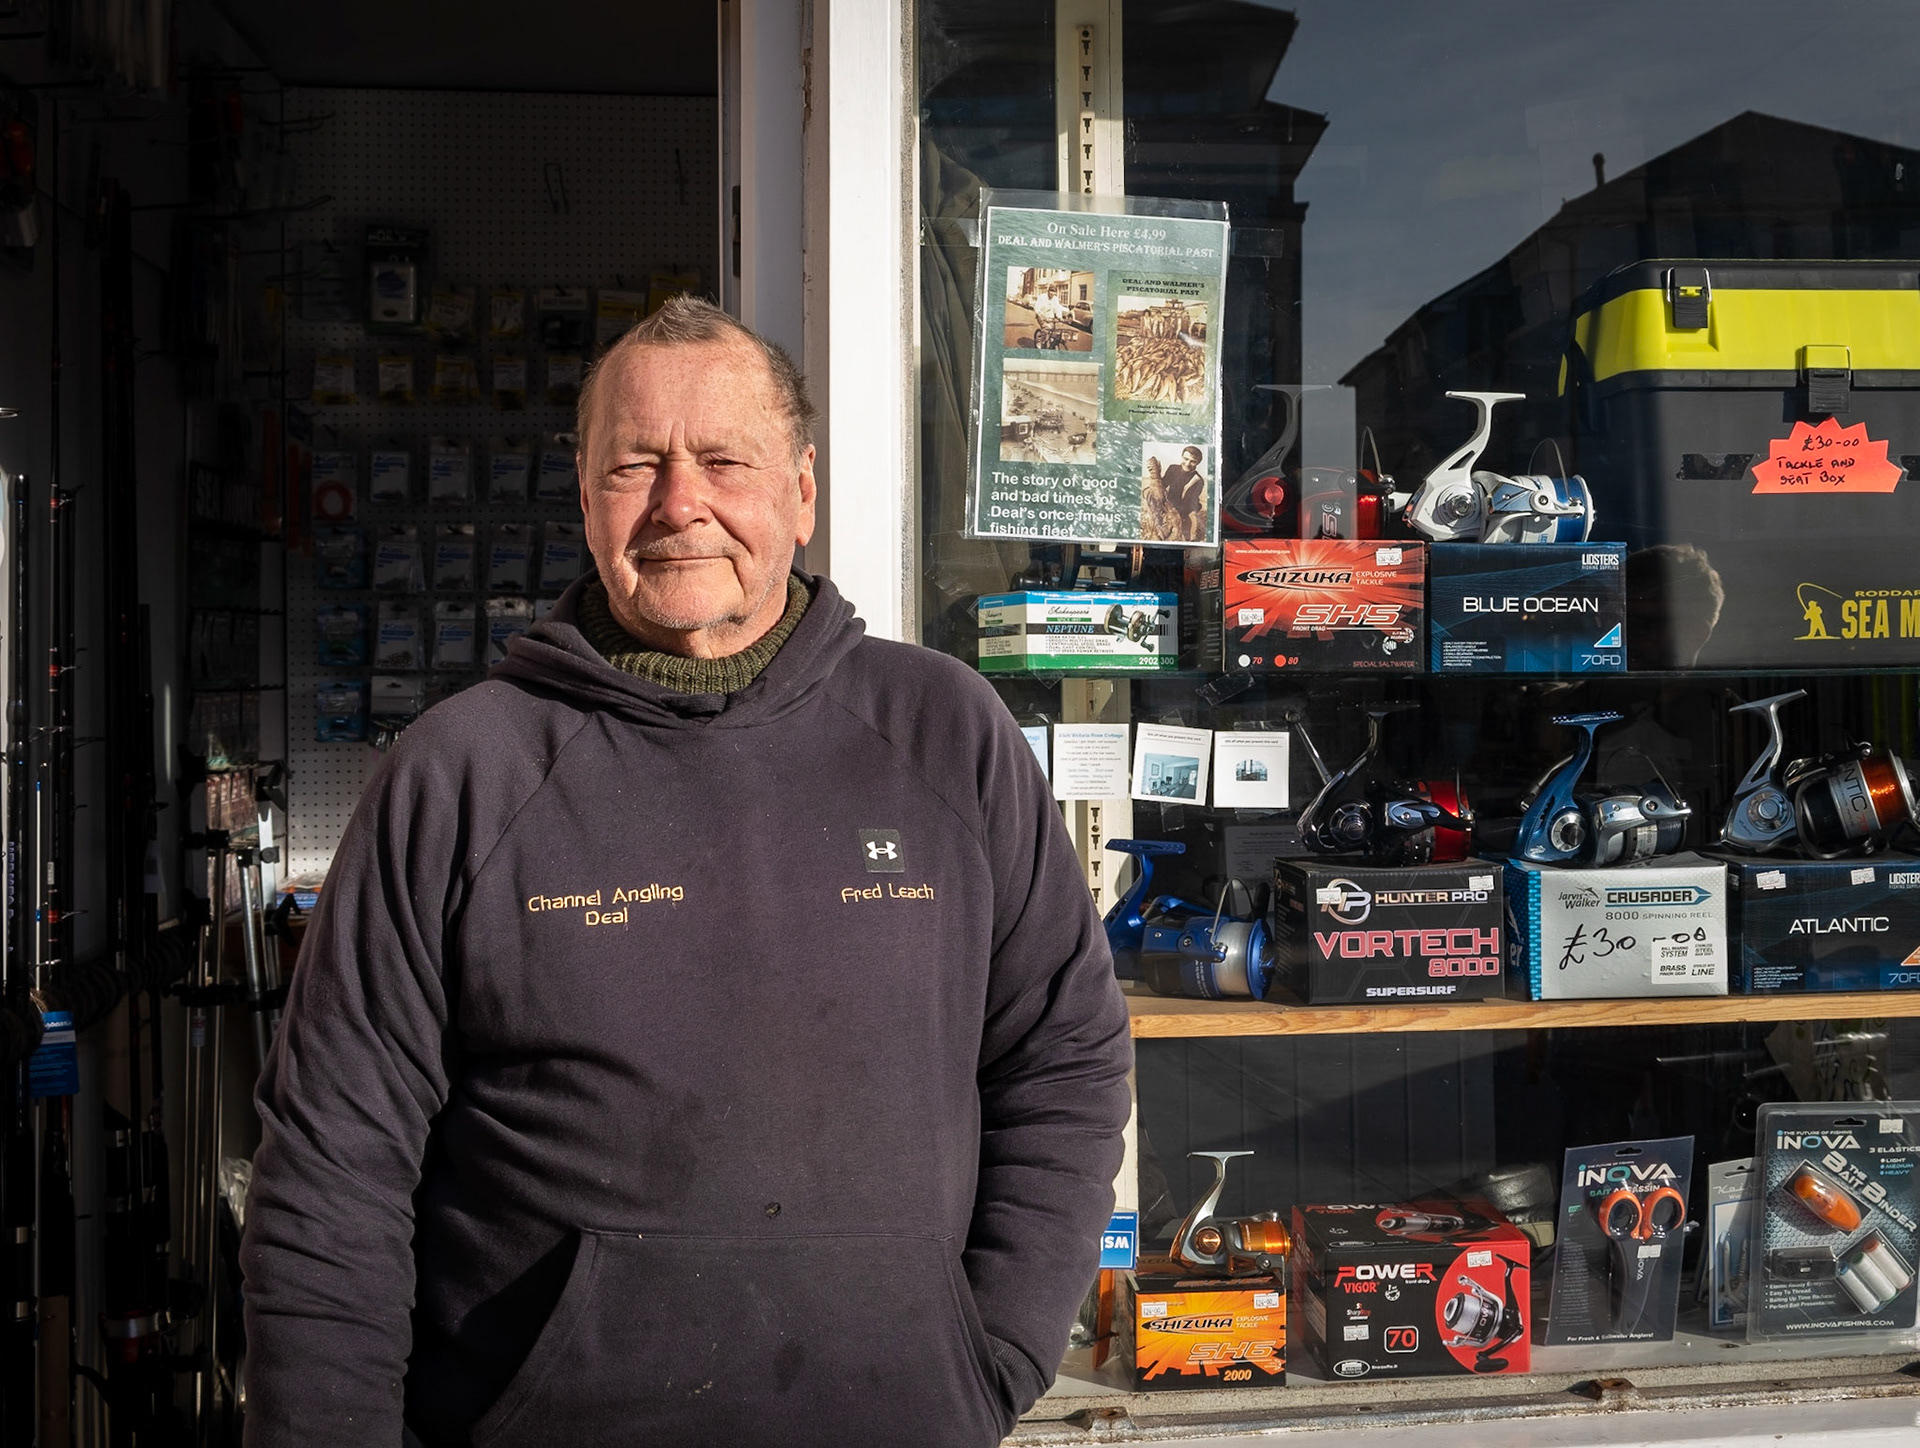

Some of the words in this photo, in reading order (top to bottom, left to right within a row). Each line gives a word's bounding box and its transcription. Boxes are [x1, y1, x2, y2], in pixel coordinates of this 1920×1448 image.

[1047, 222, 1066, 234] On
[1069, 224, 1096, 237] Sale
[1100, 226, 1130, 239] Here
[1133, 228, 1167, 241] £4.99
[998, 235, 1027, 246] DEAL
[1030, 237, 1052, 248] AND
[1054, 239, 1110, 252] WALMER'S
[1112, 243, 1183, 256] PISCATORIAL
[1186, 248, 1215, 258] PAST
[1126, 286, 1179, 295] PISCATORIAL
[1162, 280, 1205, 288] WALMER'S
[1777, 457, 1823, 468] TACKLE
[1831, 458, 1855, 468] AND
[991, 471, 1018, 484] The
[1022, 473, 1059, 489] story
[1062, 474, 1076, 487] of
[1082, 477, 1118, 490] good
[1780, 472, 1812, 485] SEAT
[1820, 473, 1846, 484] BOX
[991, 490, 1018, 502] and
[1022, 491, 1049, 503] bad
[1053, 492, 1092, 505] times
[1039, 509, 1074, 520] once
[990, 522, 1038, 536] fishing
[1581, 554, 1620, 565] LIDSTERS
[1247, 571, 1352, 584] SHIZUKA
[1463, 597, 1519, 612] BLUE
[1523, 597, 1598, 612] OCEAN
[1841, 600, 1890, 638] SEA
[1046, 625, 1095, 633] NEPTUNE
[1139, 657, 1158, 665] 2902
[1160, 657, 1175, 665] 300
[1288, 657, 1299, 665] 80
[1581, 655, 1621, 665] 70FD
[528, 891, 602, 912] Channel
[612, 884, 685, 903] Angling
[841, 884, 882, 903] Fred
[889, 883, 935, 900] Leach
[1375, 891, 1448, 904] HUNTER
[1451, 890, 1488, 902] PRO
[1558, 891, 1583, 901] Jarvis
[1607, 890, 1692, 903] CRUSADER
[1565, 896, 1600, 909] Walker
[585, 907, 629, 926] Deal
[1605, 911, 1639, 920] 8000
[1789, 917, 1890, 934] ATLANTIC
[1314, 928, 1499, 959] VORTECH
[1661, 950, 1688, 958] SYSTEM
[1428, 957, 1499, 977] 8000
[1691, 968, 1715, 976] LINE
[1366, 985, 1456, 997] SUPERSURF
[1849, 1164, 1868, 1181] THE
[1821, 1150, 1864, 1189] BAIT
[1861, 1181, 1918, 1233] BINDER
[1334, 1263, 1437, 1287] POWER
[1343, 1281, 1377, 1293] VIGOR
[1150, 1318, 1232, 1329] SHIZUKA
[1786, 1319, 1895, 1331] WWW.INOVAFISHING.COM
[1388, 1329, 1416, 1348] 70
[1188, 1341, 1276, 1360] SH6
[1223, 1370, 1253, 1381] 2000
